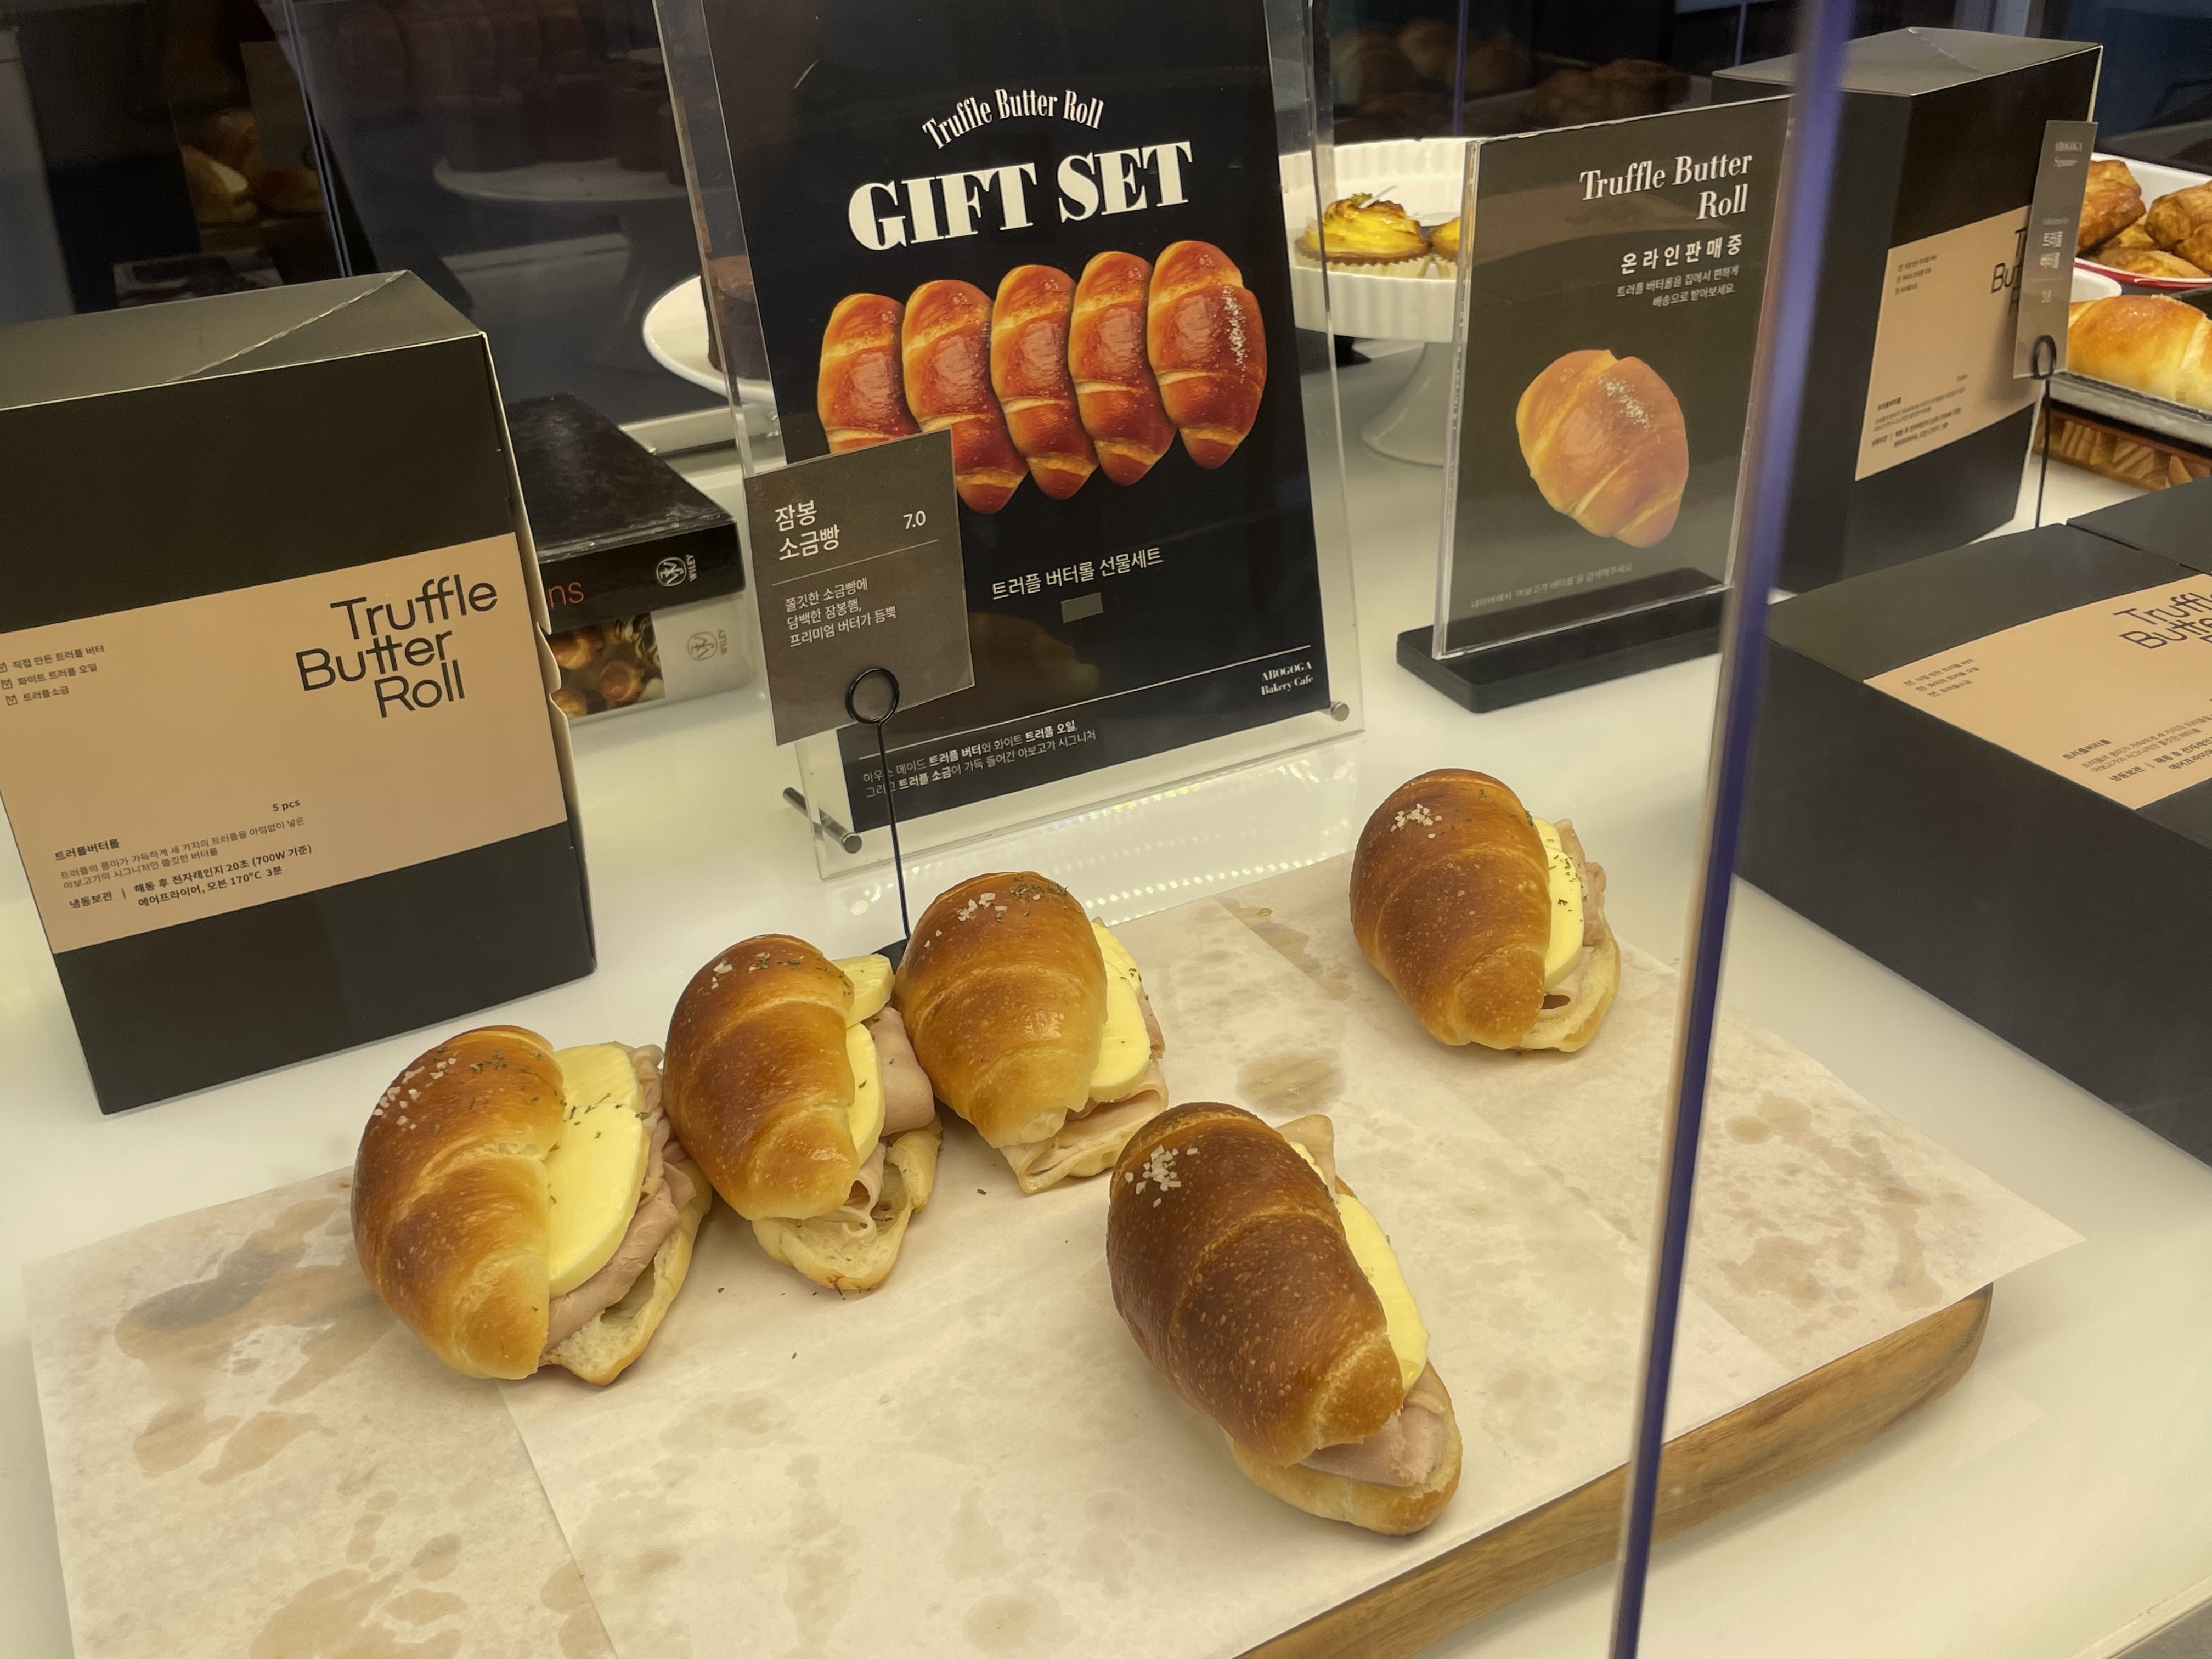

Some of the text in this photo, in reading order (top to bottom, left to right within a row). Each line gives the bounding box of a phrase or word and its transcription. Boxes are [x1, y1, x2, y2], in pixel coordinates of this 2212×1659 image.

[922, 88, 1104, 149] Truffle Butter Roll
[1579, 154, 1753, 200] Truffle Butter
[848, 140, 1193, 251] GIFT SET
[1696, 183, 1748, 221] Roll
[1616, 264, 1740, 297] 트러플 버터롤을 집에서 편하게
[1652, 291, 1688, 307] 배송으로
[775, 499, 817, 532] 잠봉
[903, 510, 927, 529] 7.0
[779, 524, 840, 560] 소금빵
[686, 554, 697, 582] WILEY
[992, 547, 1163, 600] 트러플 버터롤 선물세트
[330, 574, 498, 639] Truffle
[548, 582, 584, 608] ns
[785, 577, 868, 613] 쫄깃한 소금빵에
[2112, 592, 2212, 625] Truffl
[787, 597, 862, 631] 담백한 잠봉햄,
[790, 605, 897, 647] 프리미엄 버터가 듬뿍
[718, 629, 728, 656] WILEY
[2118, 618, 2212, 649] Butte
[12, 645, 105, 669] 직접 만든 트러플 버터
[17, 663, 98, 686] 화이트 트러플 오일
[295, 630, 453, 692] Butter
[23, 685, 69, 702] 트러플소금
[374, 659, 465, 718] Roll
[1261, 674, 1313, 696] Bakery Cafe
[896, 758, 927, 775] 메이드
[929, 749, 959, 767] 트러플
[961, 742, 992, 758] 버터와
[994, 734, 1024, 751] 화이트
[1025, 725, 1054, 742] 트러플
[899, 772, 929, 789] 트러플
[932, 764, 961, 781] 소금이
[964, 758, 984, 771] 가득
[986, 751, 1015, 768] 들어간
[1018, 740, 1056, 758] 아보고가
[1058, 729, 1096, 748] 시그니처
[2180, 736, 2212, 754] 전자레인
[272, 799, 301, 812] 5 pcs
[54, 838, 120, 861] 트러플버터롤
[61, 817, 304, 879] 트러플의 풍미가 가득하게 세 가지의 트러플을 아낌없이 넣은
[63, 847, 218, 889] 아보고가의 시그니처인 쫄깃한 버터롤
[69, 844, 312, 909] 냉동보관 해동 후 전자레인지 20초 (700W 기준)
[138, 884, 205, 907] 에어프라이어,
[207, 878, 227, 891] 오븐
[266, 865, 283, 877] 3분
